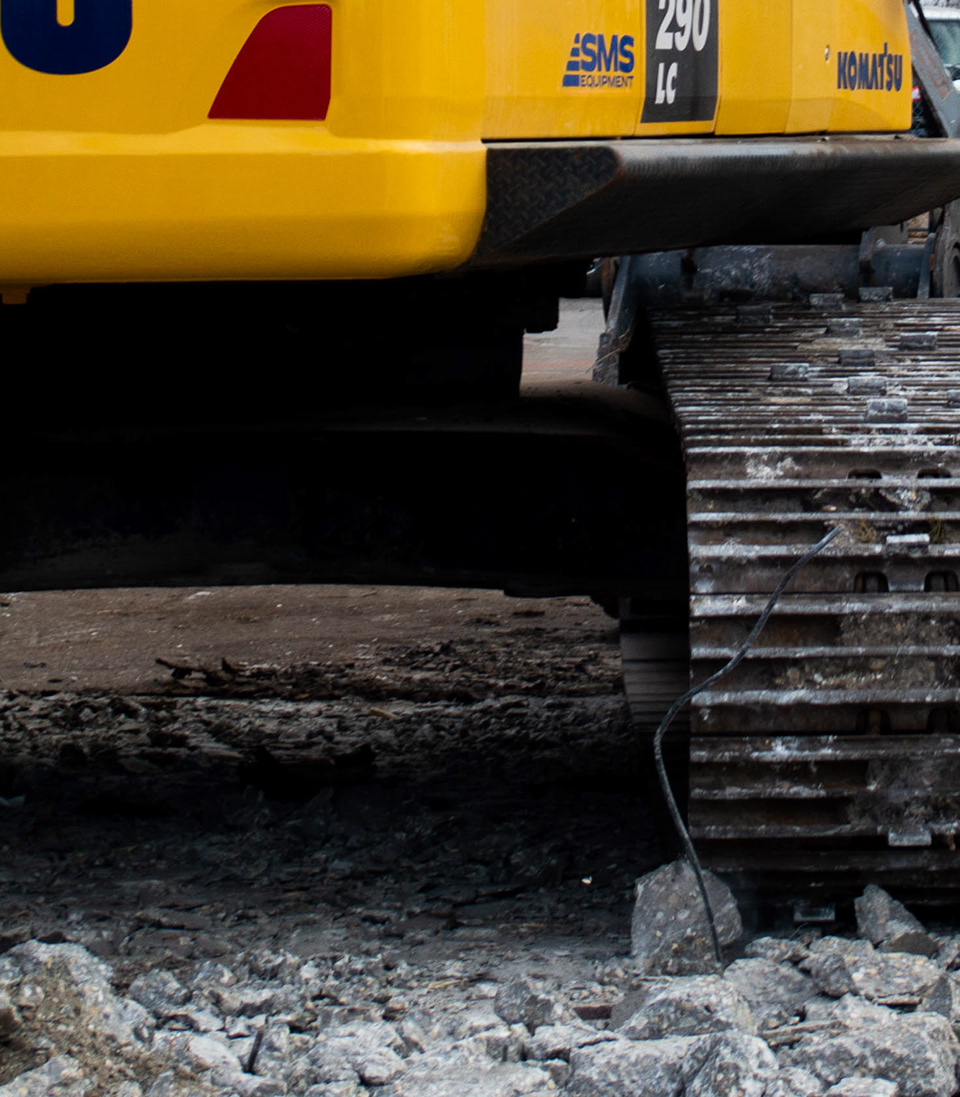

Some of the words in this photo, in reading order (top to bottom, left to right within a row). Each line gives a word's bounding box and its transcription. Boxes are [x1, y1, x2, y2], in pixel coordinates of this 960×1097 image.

[581, 32, 635, 74] SMS
[837, 42, 903, 92] KOMATSU
[580, 74, 635, 88] EQUIPMENT
[654, 61, 679, 105] LC
